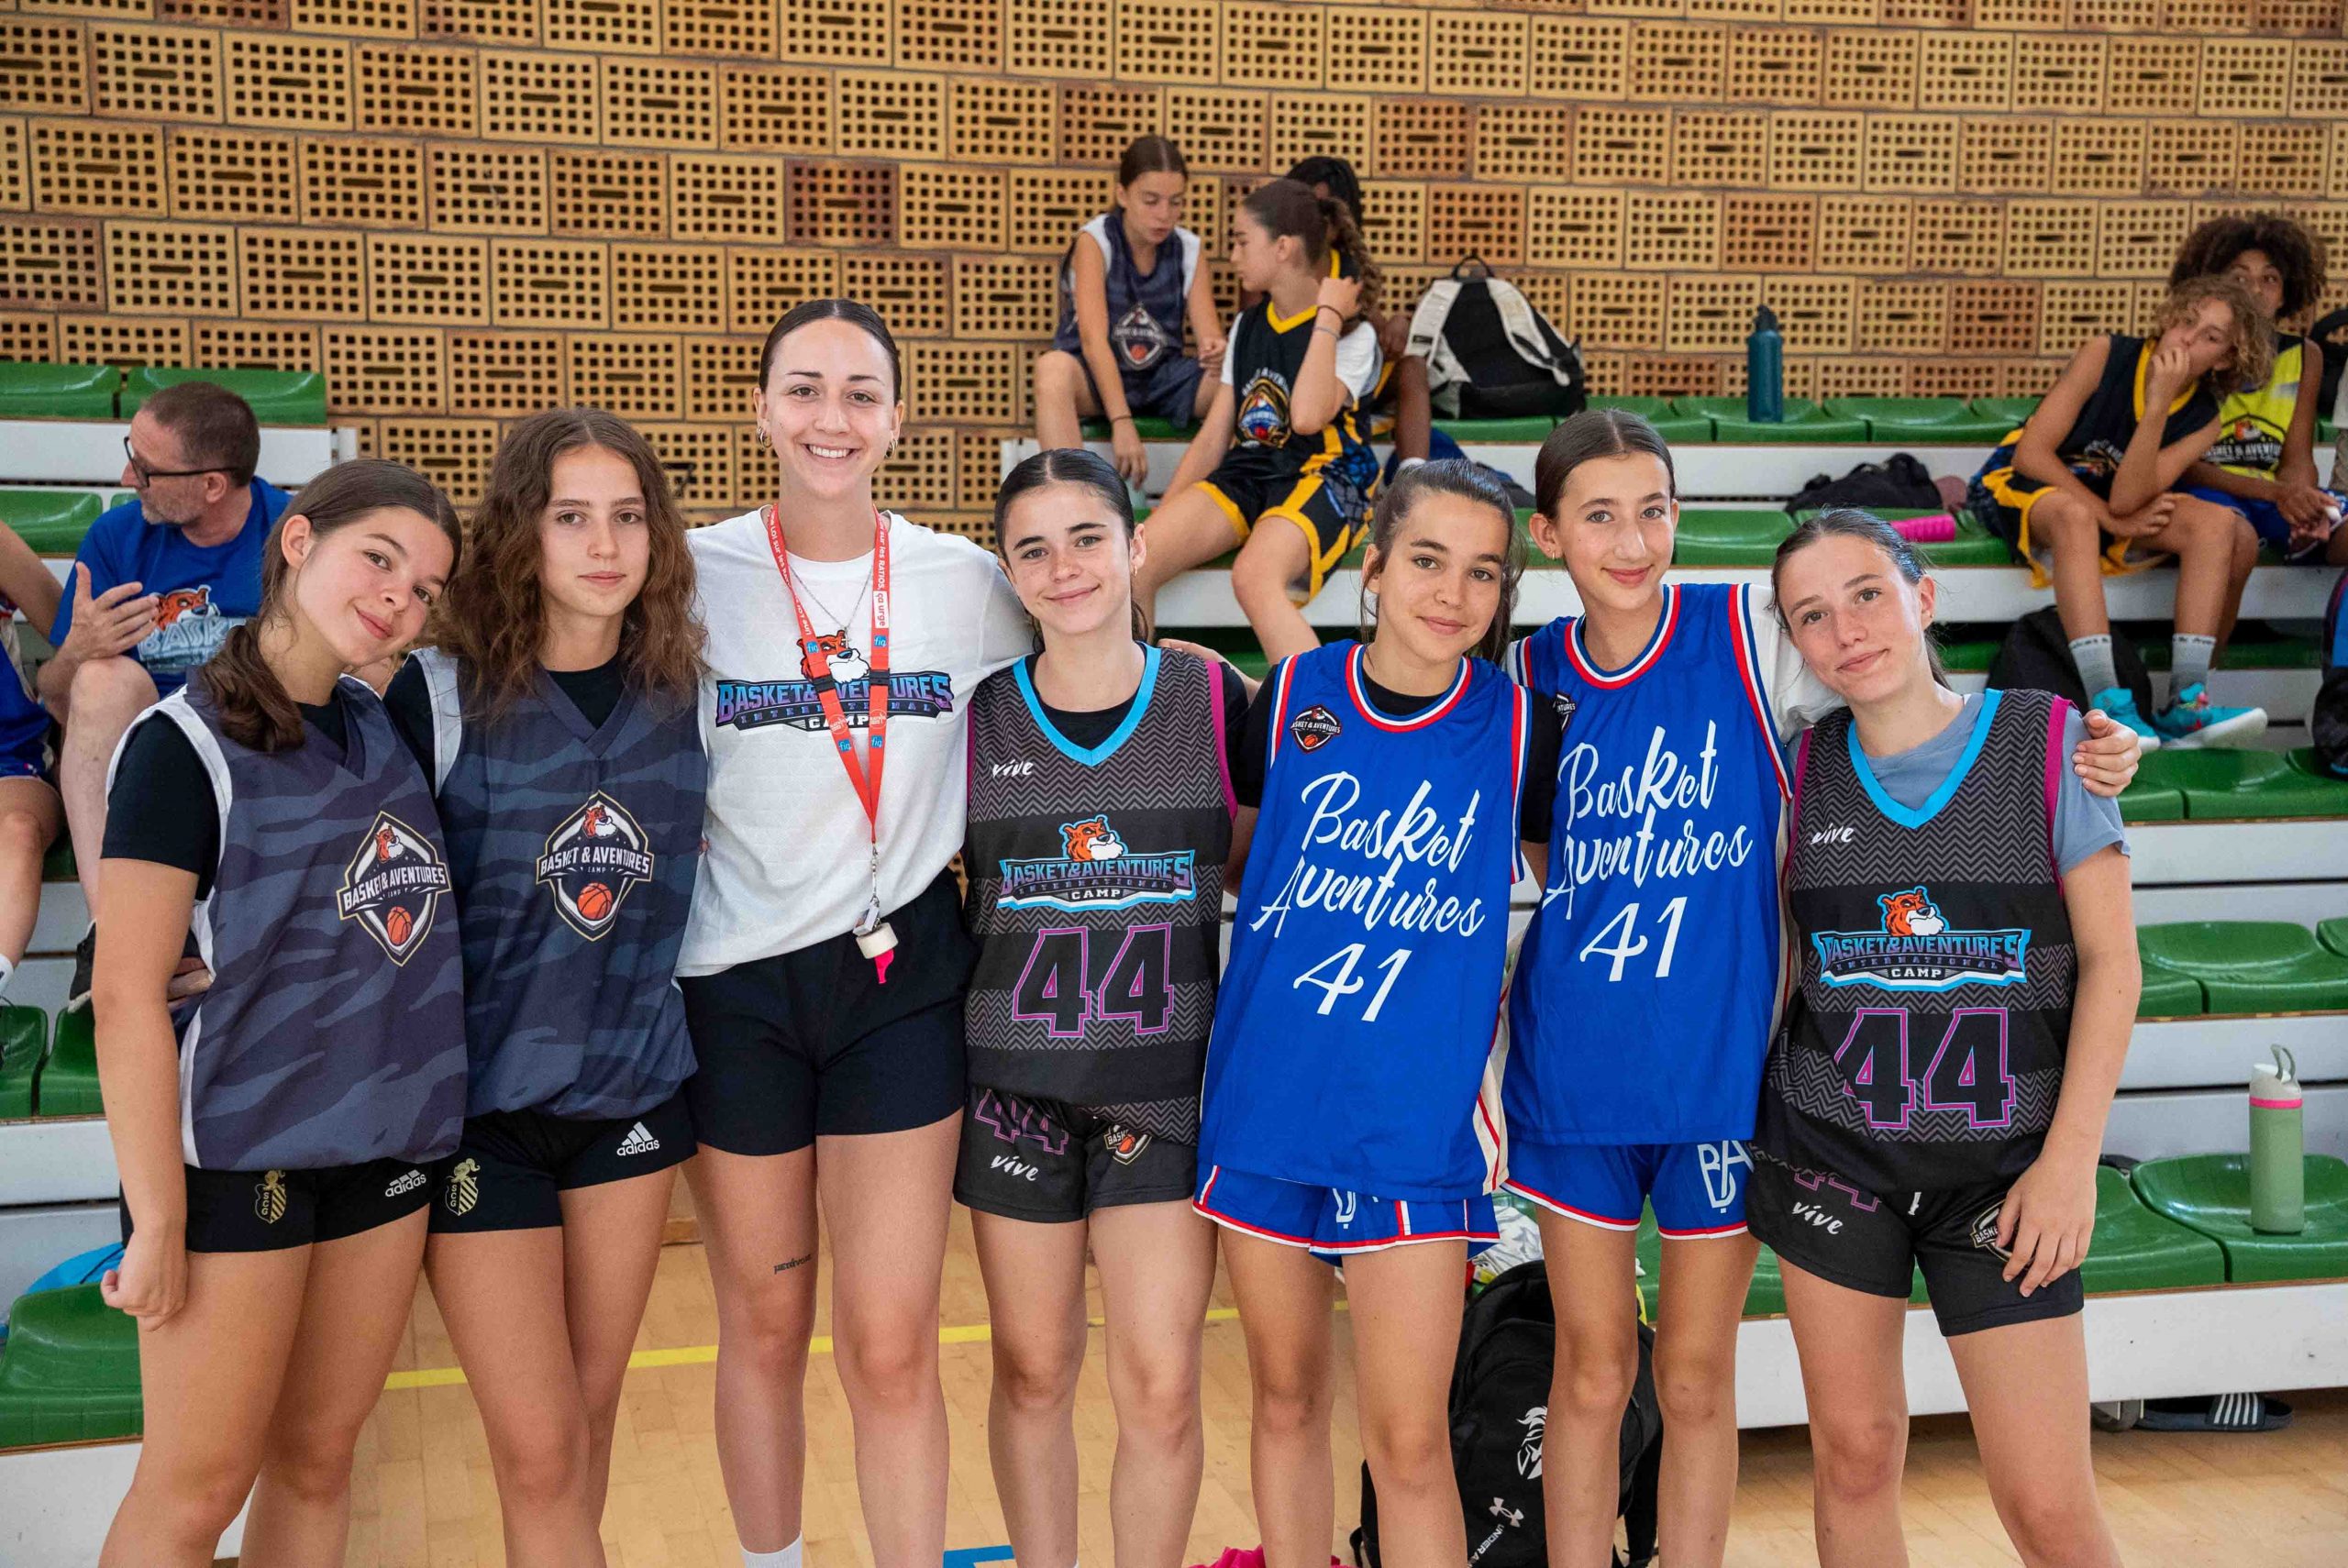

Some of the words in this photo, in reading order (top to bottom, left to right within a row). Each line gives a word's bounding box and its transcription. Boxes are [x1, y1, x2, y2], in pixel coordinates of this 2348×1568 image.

[877, 605, 886, 626] urge
[138, 617, 227, 657] BASK
[992, 759, 1034, 778] vive
[1557, 719, 1719, 831] Basket
[1301, 771, 1480, 873] Basket
[1811, 823, 1855, 845] vive
[540, 846, 580, 876] BASKET
[581, 846, 591, 864] &
[593, 846, 650, 875] AVENTURES
[1542, 802, 1754, 920] Aventures
[381, 871, 389, 890] &
[390, 866, 446, 888] AVENTURES
[1019, 878, 1168, 895] INTERNATIONAL
[1071, 889, 1121, 900] CAMP
[1249, 852, 1486, 938] Aventures
[1579, 896, 1688, 982] 41
[1835, 956, 1998, 971] INTERNATIONAL
[1891, 968, 1942, 978] CAMP
[1012, 922, 1174, 1037] 44
[1292, 943, 1412, 1022] 41
[1834, 1007, 2017, 1129] 44
[616, 1138, 660, 1156] adidas
[1108, 1129, 1129, 1145] BASK
[991, 1154, 1039, 1181] vive
[385, 1174, 426, 1198] adidas
[1791, 1201, 1844, 1234] vive
[1974, 1225, 1999, 1243] BASKE
[1477, 1523, 1504, 1554] UNDER
